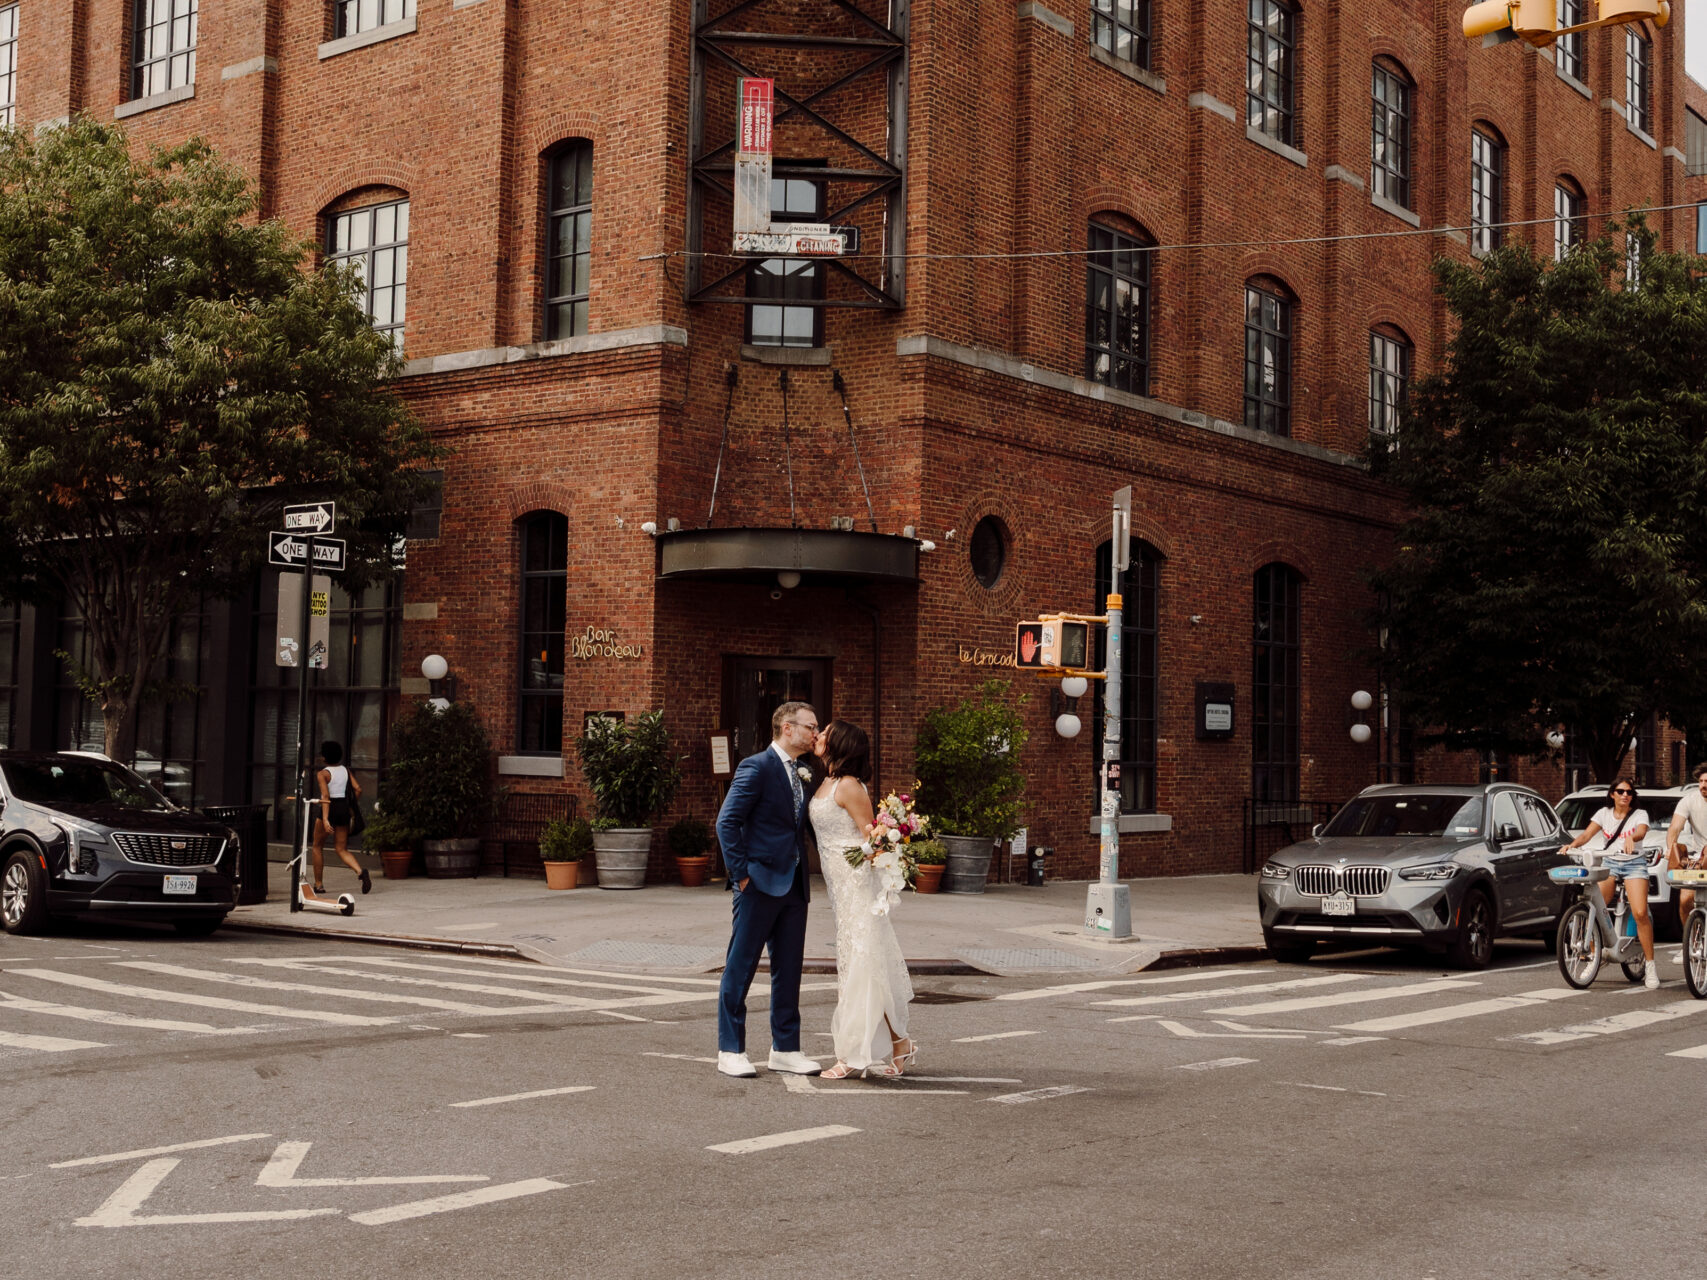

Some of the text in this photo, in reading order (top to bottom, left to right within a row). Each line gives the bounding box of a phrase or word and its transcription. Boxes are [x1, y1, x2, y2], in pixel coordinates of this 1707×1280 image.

[744, 106, 753, 147] WARNING
[800, 240, 840, 252] CLEANING
[288, 513, 325, 527] ONE WAY
[282, 543, 335, 560] ONE WAY
[313, 592, 326, 600] NYC
[587, 625, 615, 643] Bar
[572, 635, 642, 660] Blondeau
